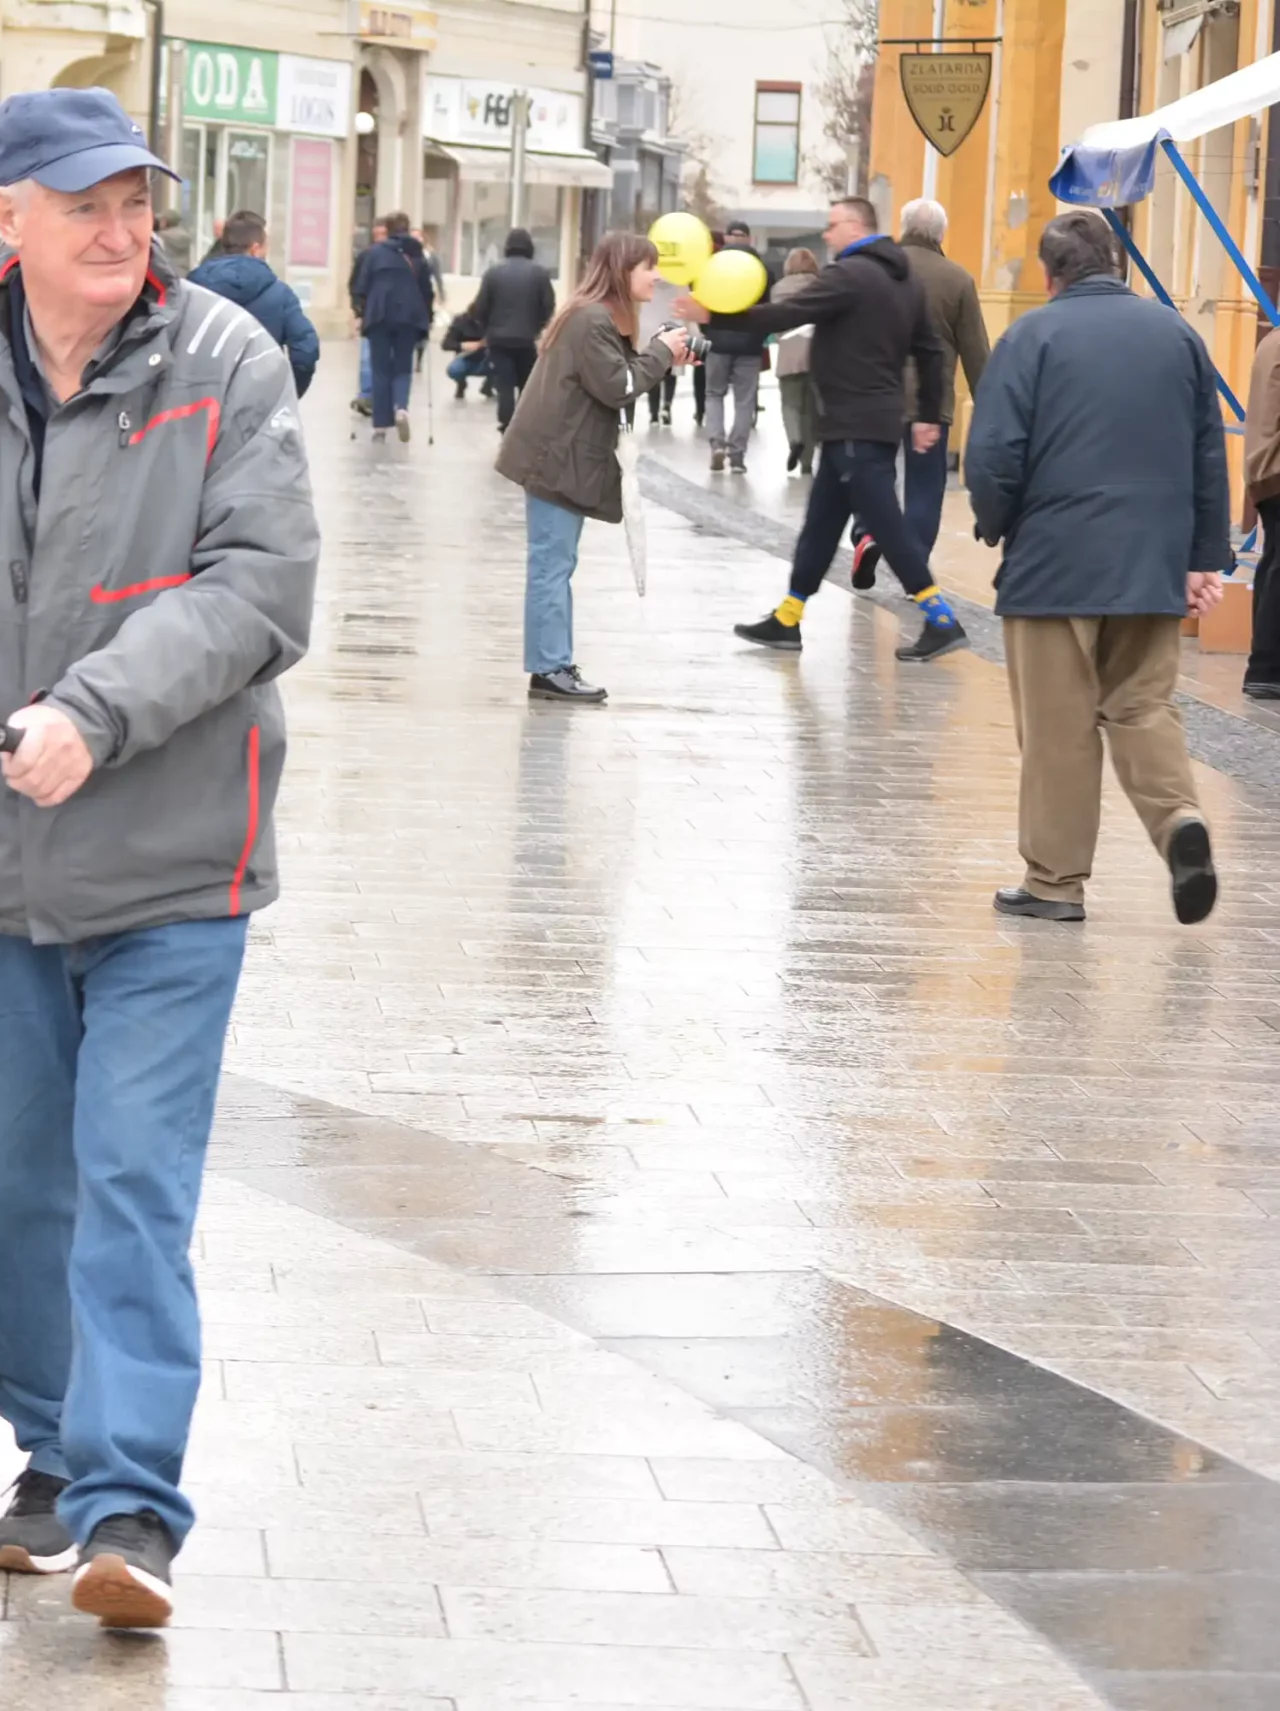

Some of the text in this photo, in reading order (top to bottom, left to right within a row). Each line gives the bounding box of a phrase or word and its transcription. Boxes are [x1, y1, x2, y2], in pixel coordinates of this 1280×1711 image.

[160, 46, 269, 113] ODA
[913, 83, 980, 94] SOLID GOLD
